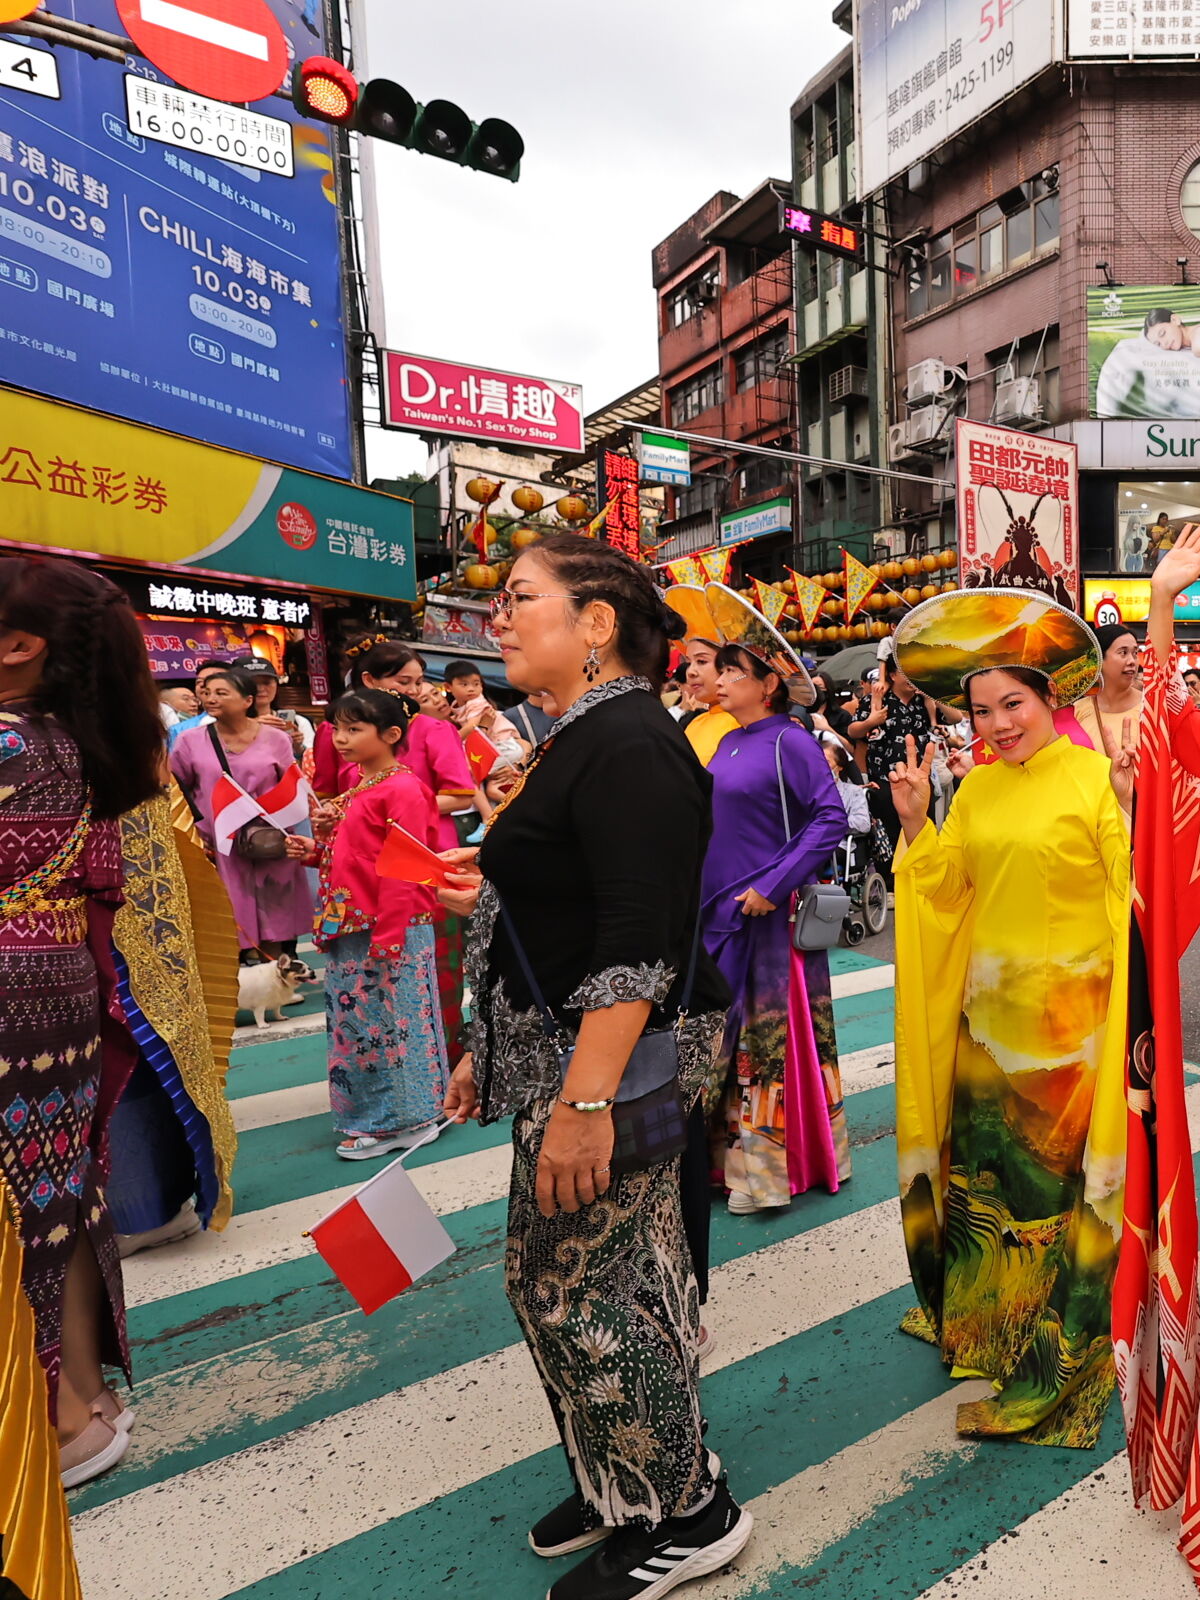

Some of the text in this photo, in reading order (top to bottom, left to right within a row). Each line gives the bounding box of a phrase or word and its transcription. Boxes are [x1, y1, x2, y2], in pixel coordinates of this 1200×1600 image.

[135, 85, 286, 146] 車輛禁行時間
[136, 110, 286, 168] 16:00-00:00
[400, 363, 558, 427] Dr.情趣
[561, 385, 579, 398] 2F
[403, 407, 455, 425] Taiwan's
[485, 420, 506, 433] Sex
[506, 425, 528, 438] Toy
[528, 427, 557, 442] Shop
[642, 449, 689, 465] FamilyMart
[969, 440, 1069, 479] 田都元帥
[0, 446, 168, 514] 公益彩券
[327, 530, 407, 567] 台灣彩券
[1100, 611, 1117, 624] 30
